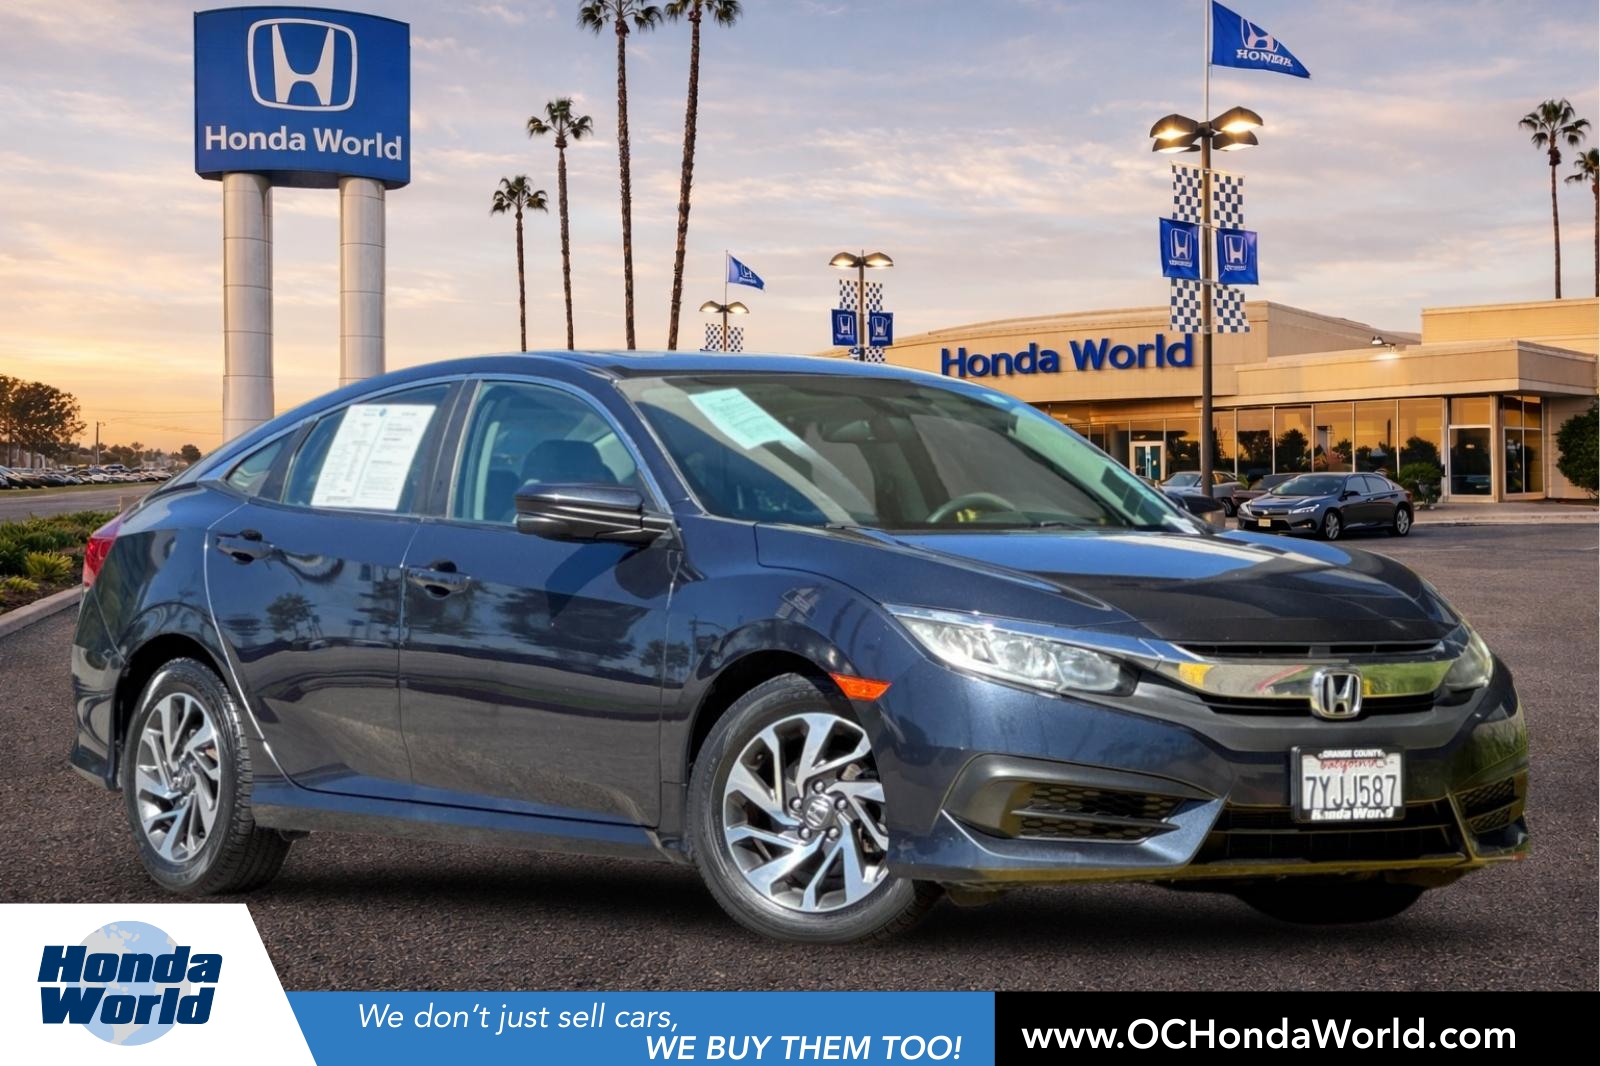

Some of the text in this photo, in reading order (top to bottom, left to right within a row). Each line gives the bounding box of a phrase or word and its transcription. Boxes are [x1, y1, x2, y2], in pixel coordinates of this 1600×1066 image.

[205, 125, 402, 161] Honda World
[941, 333, 1194, 377] Honda World
[1305, 774, 1397, 809] 7YJJ587
